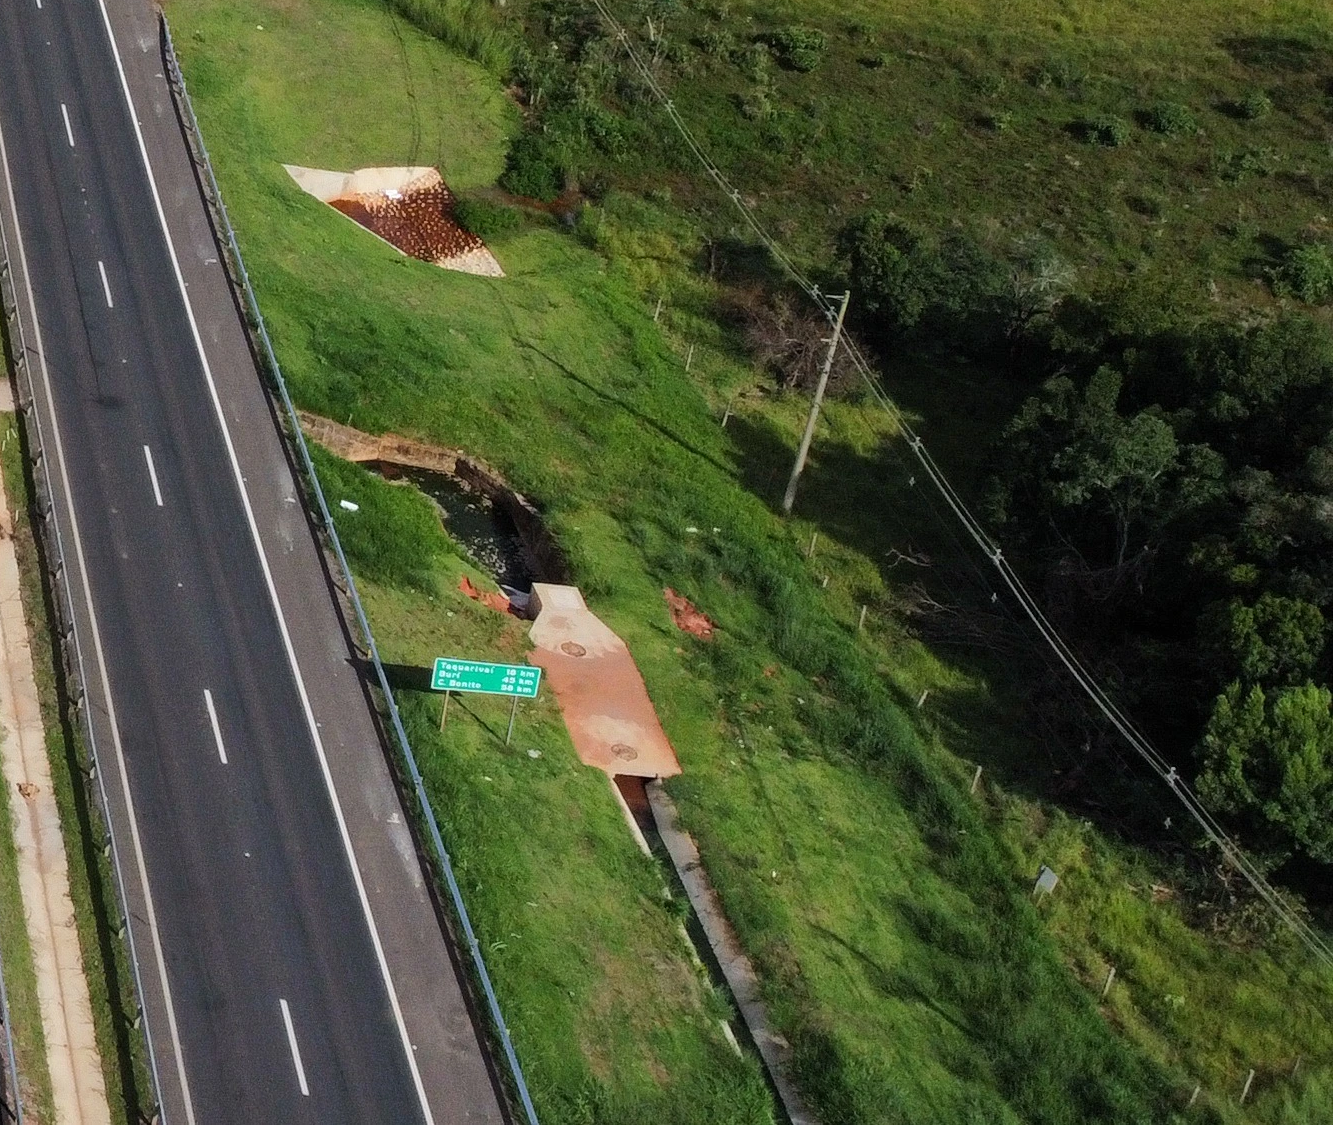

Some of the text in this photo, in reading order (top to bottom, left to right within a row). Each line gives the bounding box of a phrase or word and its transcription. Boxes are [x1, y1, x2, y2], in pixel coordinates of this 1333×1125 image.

[520, 670, 535, 678] km
[449, 679, 482, 689] Bonito
[516, 685, 532, 693] km
[518, 678, 534, 686] km
